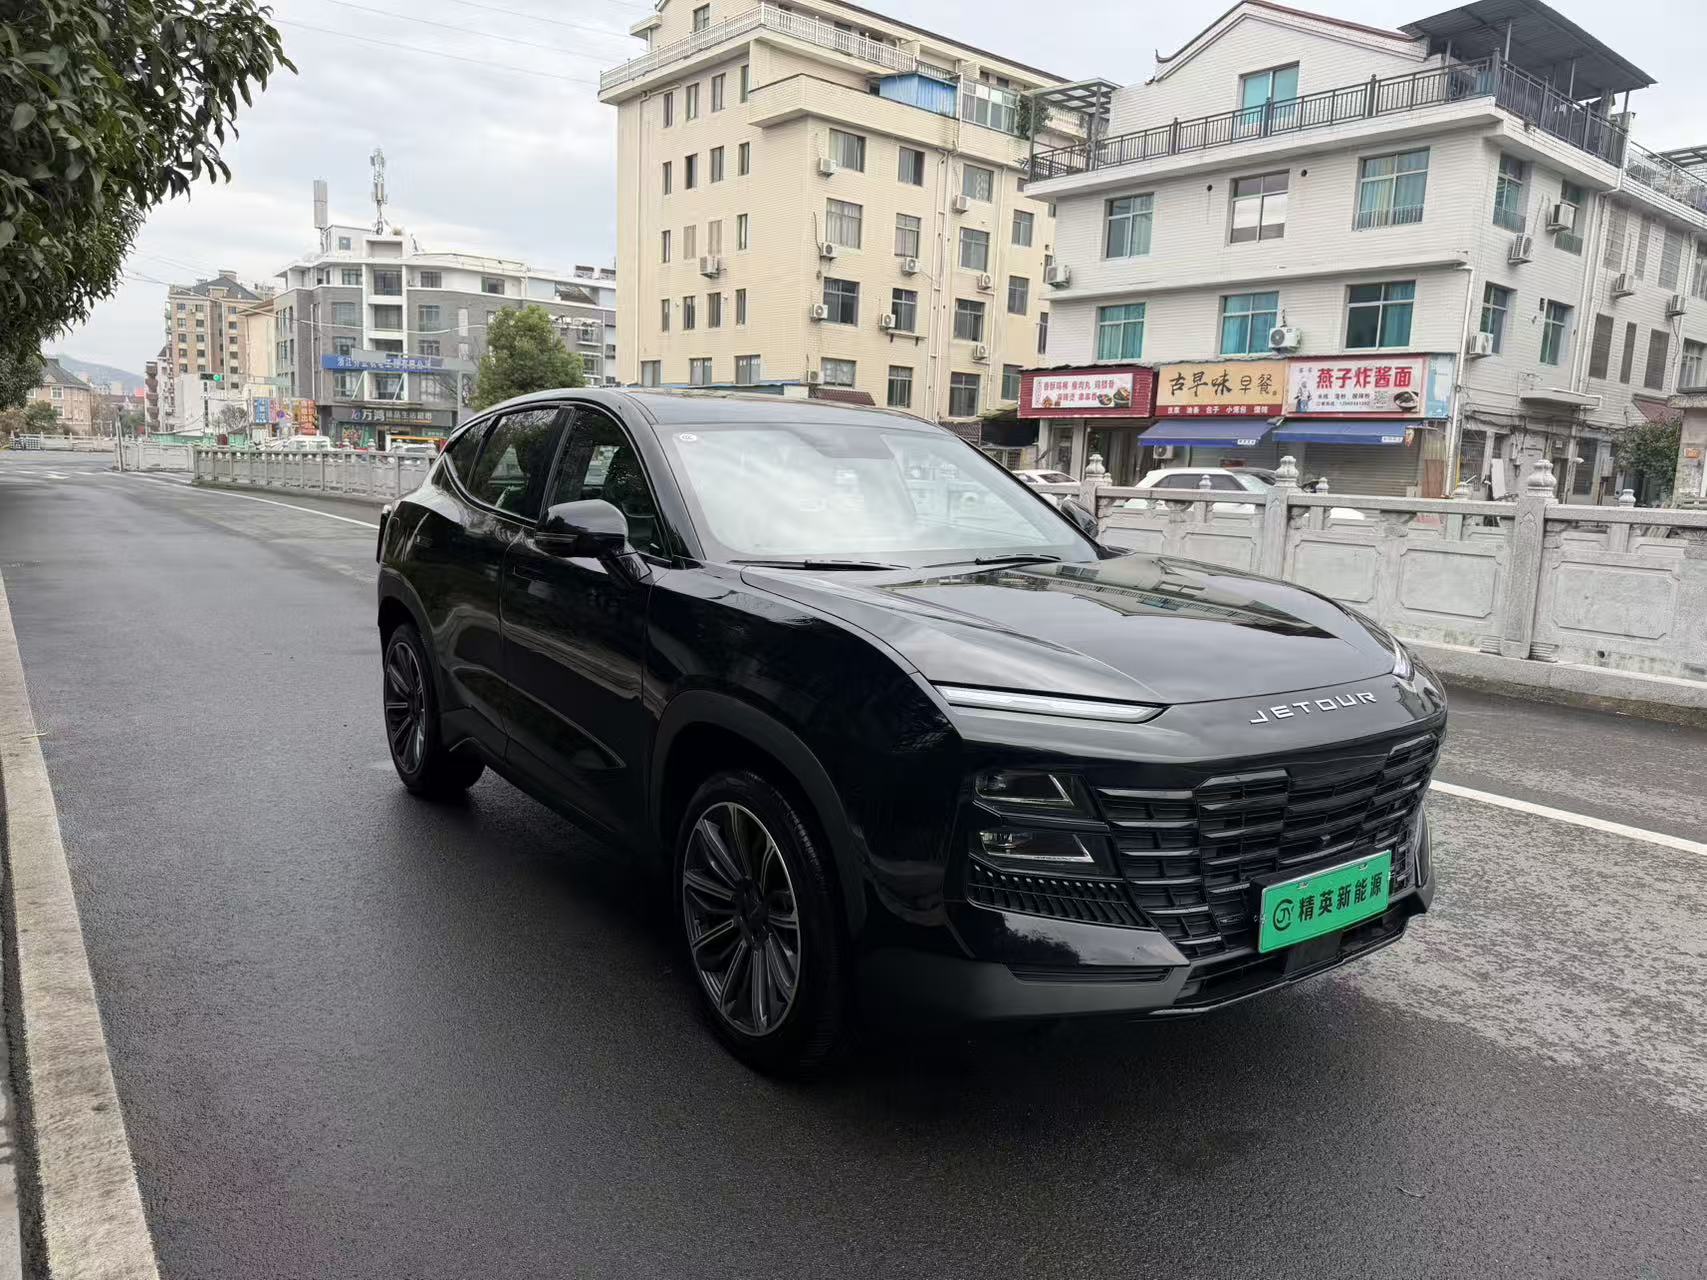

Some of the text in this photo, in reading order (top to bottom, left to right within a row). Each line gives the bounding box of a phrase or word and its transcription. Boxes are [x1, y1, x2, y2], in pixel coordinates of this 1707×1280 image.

[1316, 366, 1413, 390] 燕子炸酱面
[1249, 692, 1377, 724] JETOUR
[1298, 872, 1383, 922] 精英新能源
